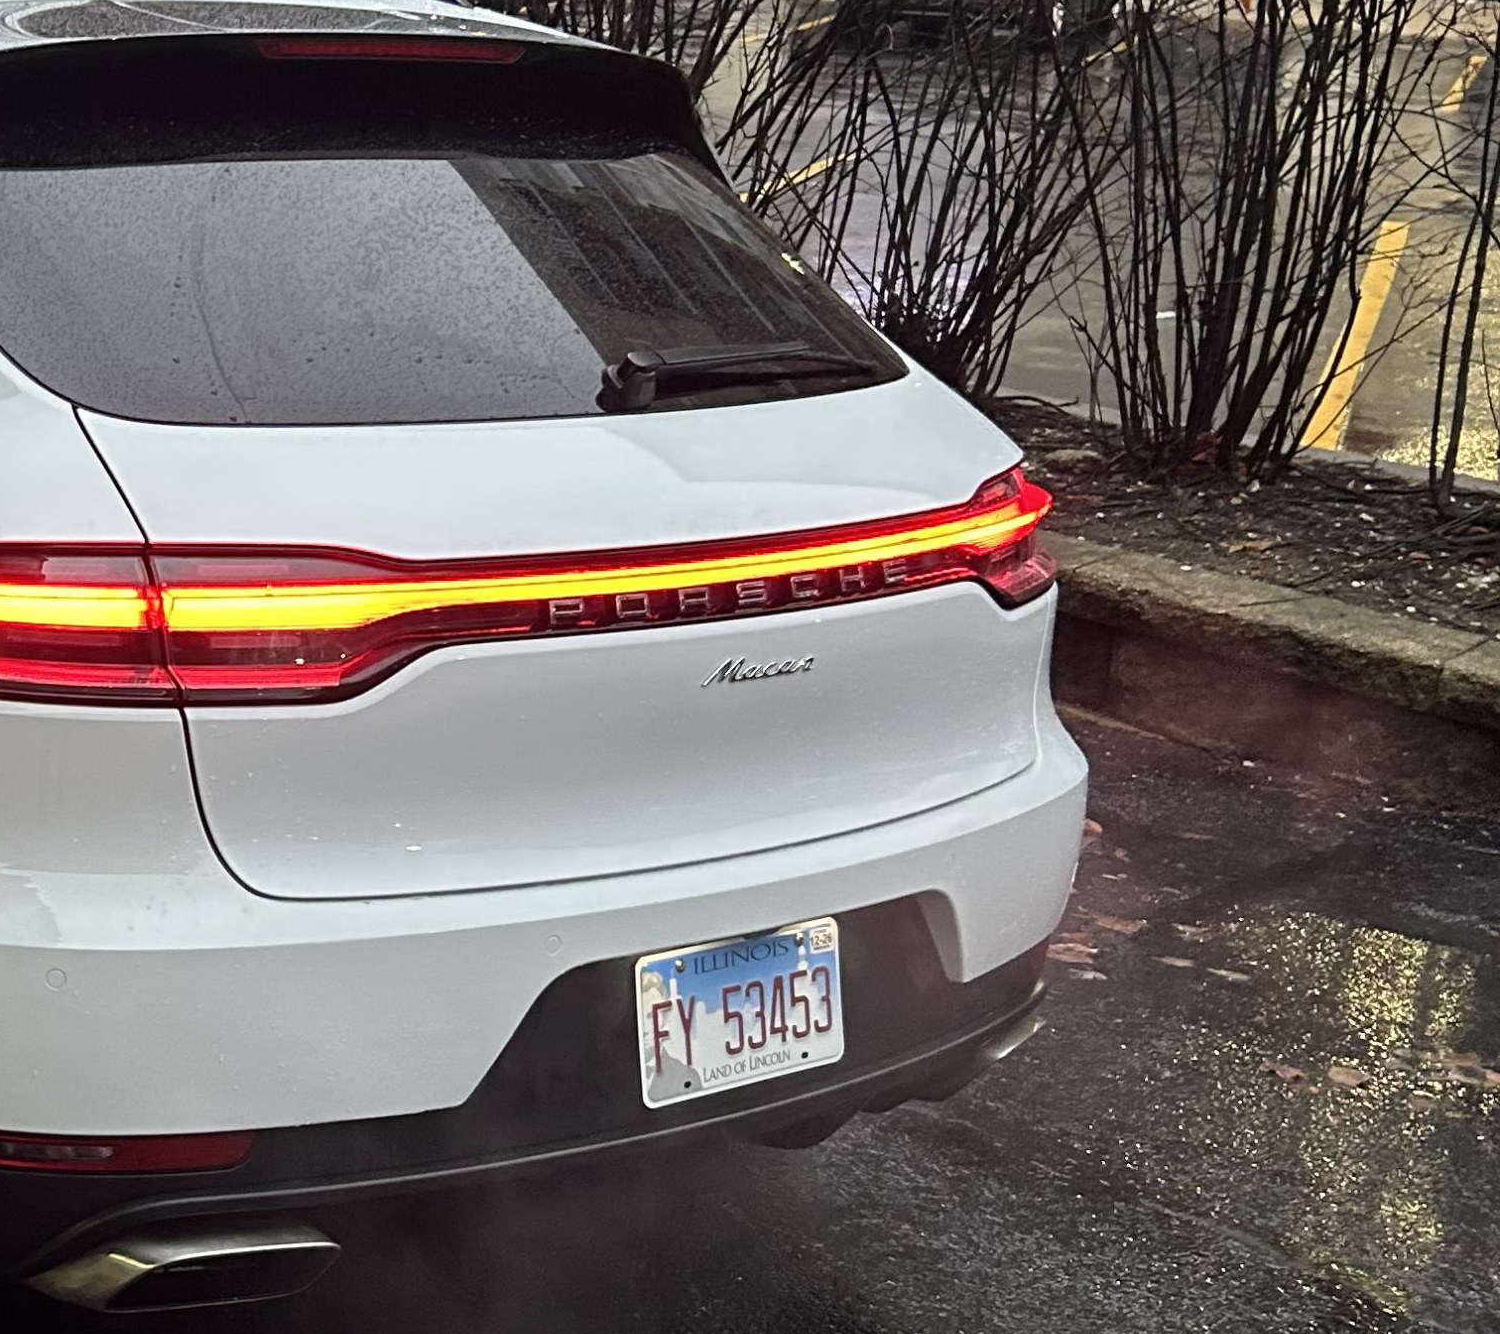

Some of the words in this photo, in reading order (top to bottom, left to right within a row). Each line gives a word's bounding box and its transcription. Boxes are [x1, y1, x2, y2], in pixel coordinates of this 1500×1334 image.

[549, 558, 908, 626] PORSCHE
[700, 654, 815, 689] Macan
[693, 940, 789, 974] ILLINOIS
[652, 995, 695, 1075] FY
[721, 965, 833, 1056] 53453
[703, 1063, 732, 1083] LAND
[733, 1060, 748, 1075] OF
[749, 1050, 791, 1071] LINCOLN
